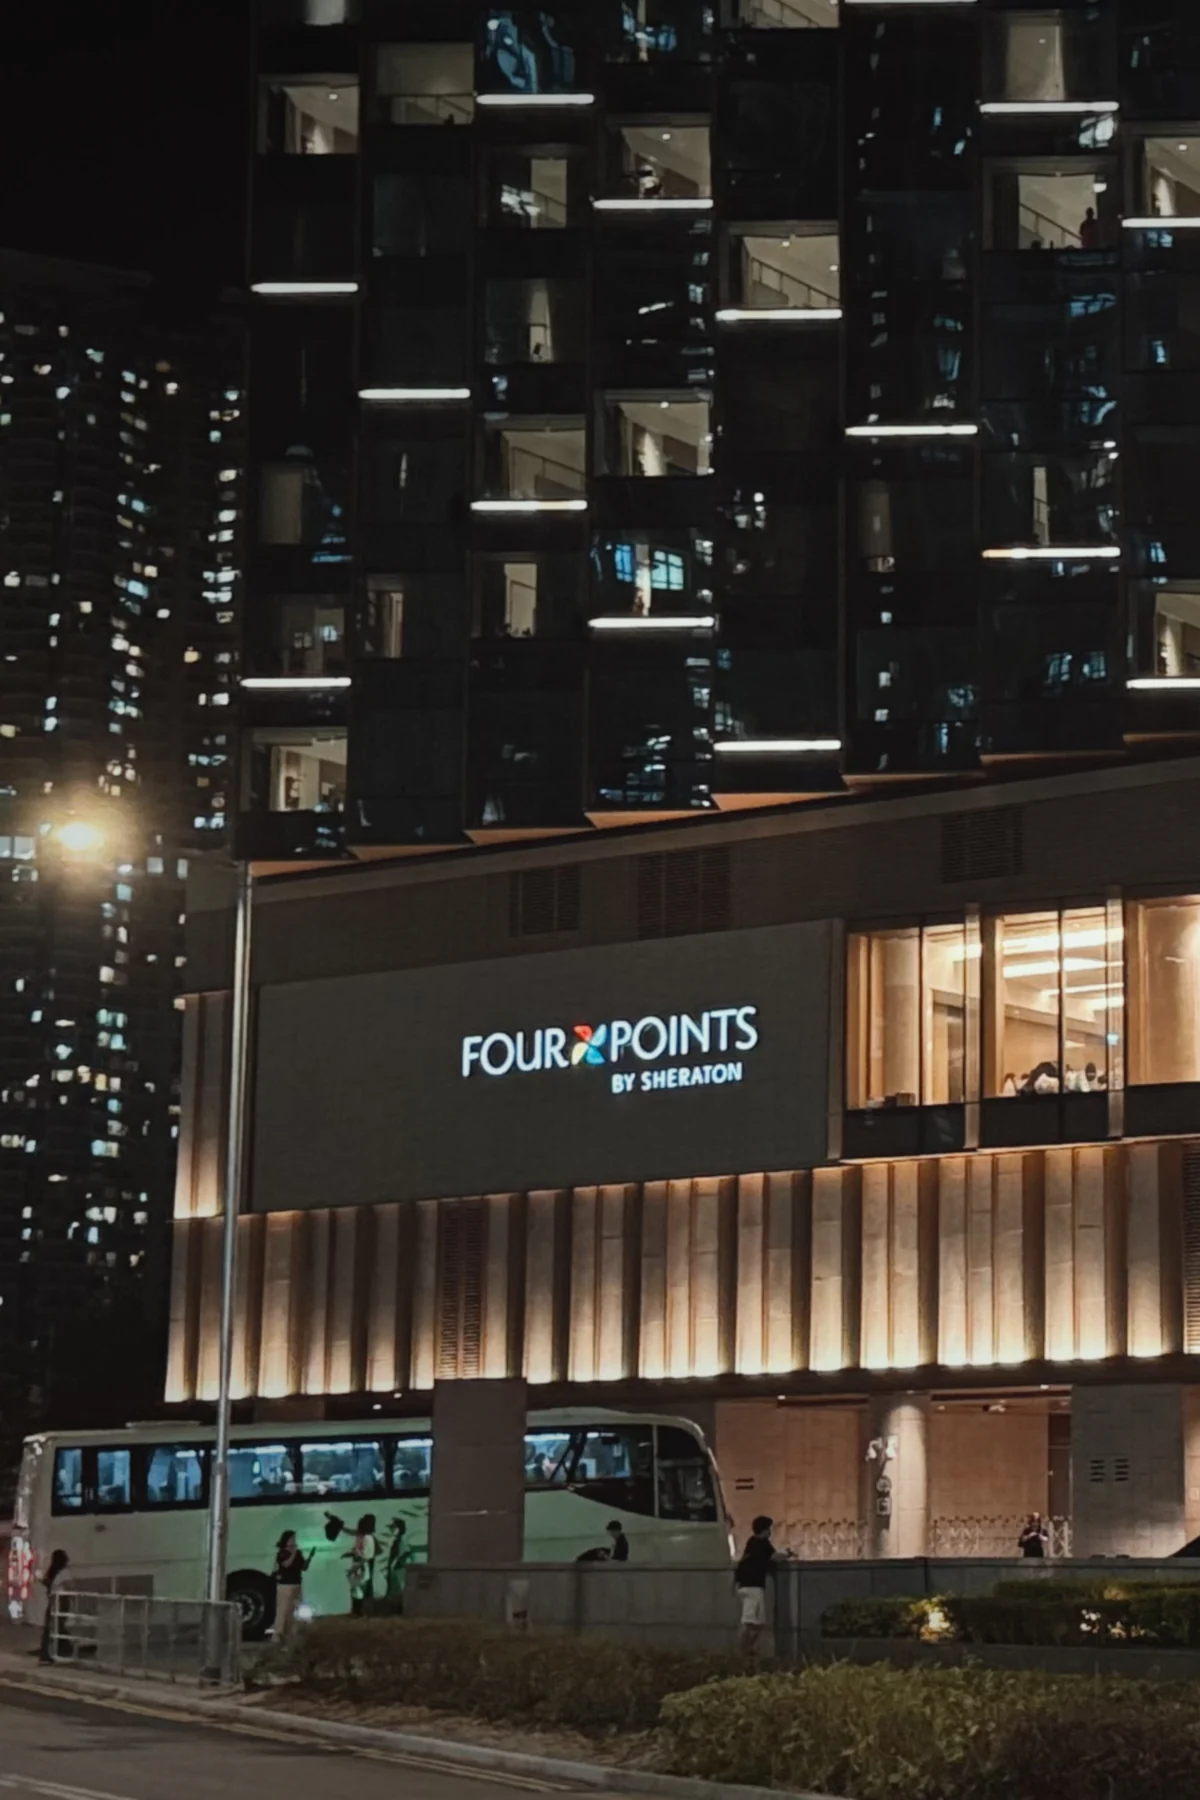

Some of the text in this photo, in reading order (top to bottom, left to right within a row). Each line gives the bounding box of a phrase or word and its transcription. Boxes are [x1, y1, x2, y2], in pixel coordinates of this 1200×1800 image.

[461, 1005, 759, 1078] FOUR POINTS
[611, 1061, 743, 1094] BY SHERATON
